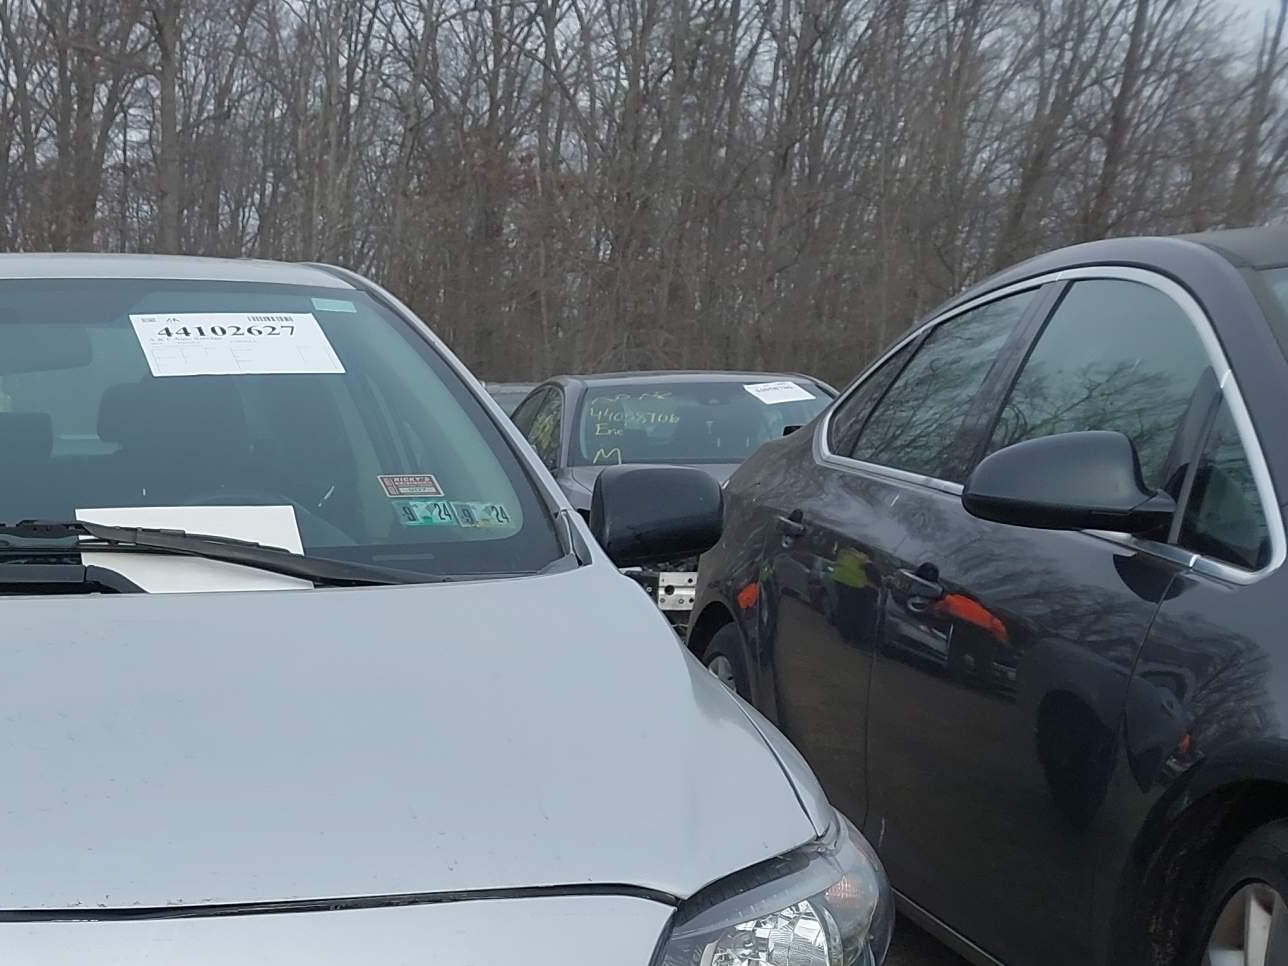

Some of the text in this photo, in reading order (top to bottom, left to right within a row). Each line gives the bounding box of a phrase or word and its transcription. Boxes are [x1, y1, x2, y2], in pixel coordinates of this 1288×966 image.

[157, 325, 295, 337] 44102627
[433, 503, 453, 520] 24
[491, 505, 511, 523] 24
